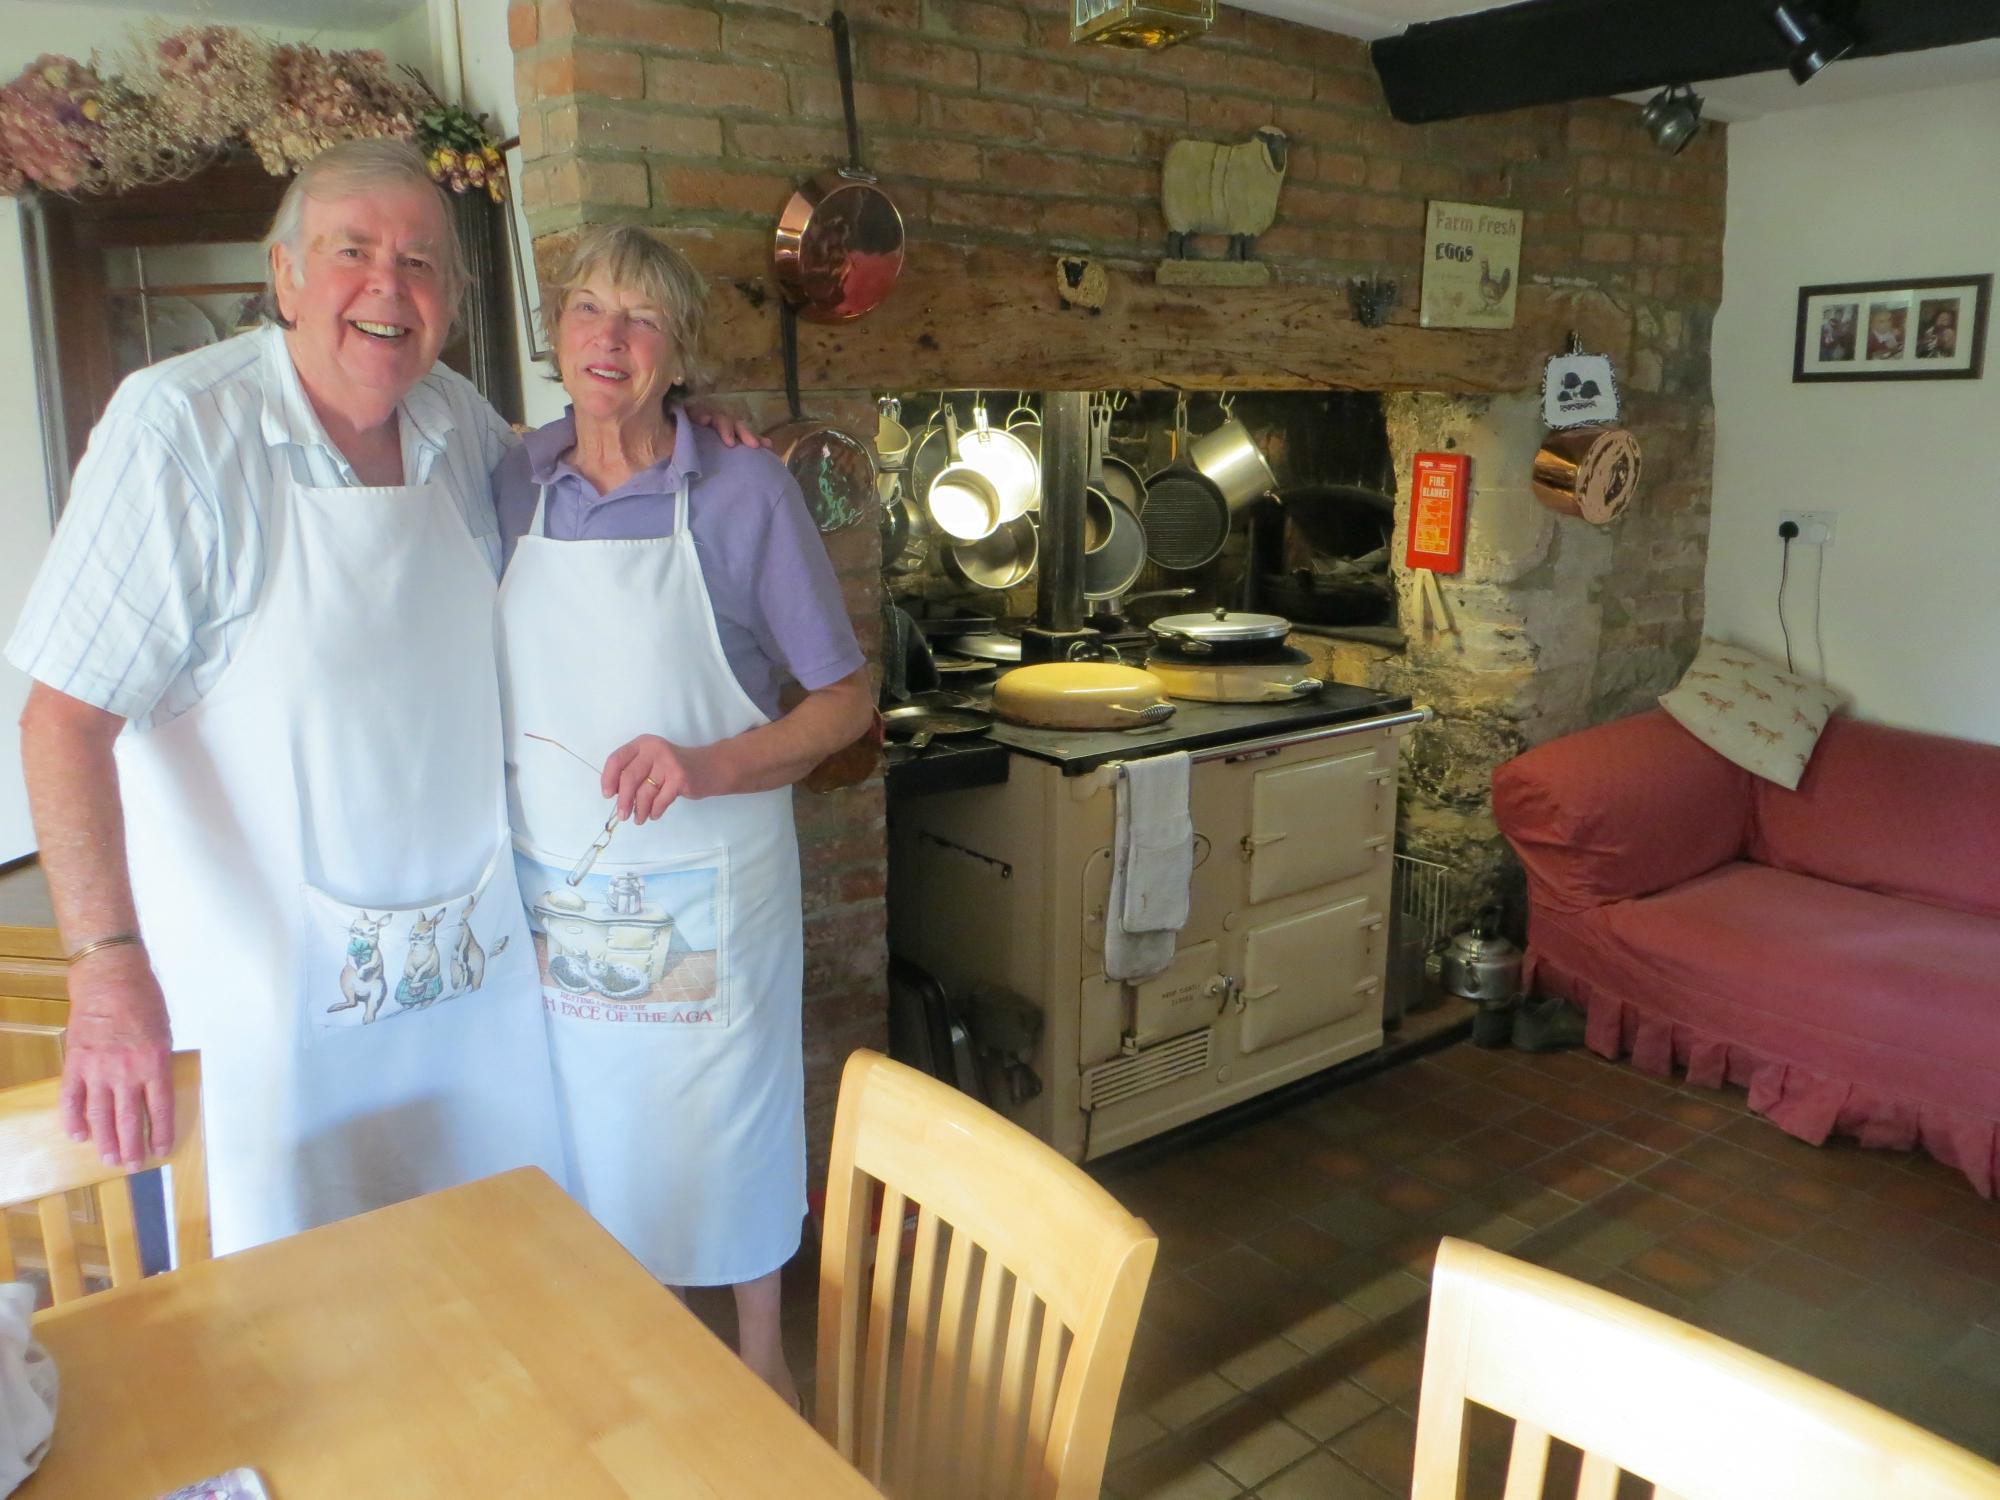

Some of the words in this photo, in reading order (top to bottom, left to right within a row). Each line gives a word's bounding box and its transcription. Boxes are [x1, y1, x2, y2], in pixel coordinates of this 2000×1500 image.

[1435, 208, 1474, 233] Farm
[1477, 215, 1517, 237] Fresh
[1435, 242, 1474, 263] EGGS
[1429, 475, 1446, 487] FIRE
[1422, 487, 1450, 499] BLANKET
[561, 1001, 601, 1021] FACE
[605, 1009, 628, 1023] OF
[633, 1011, 667, 1023] THE
[672, 1009, 713, 1024] AGA
